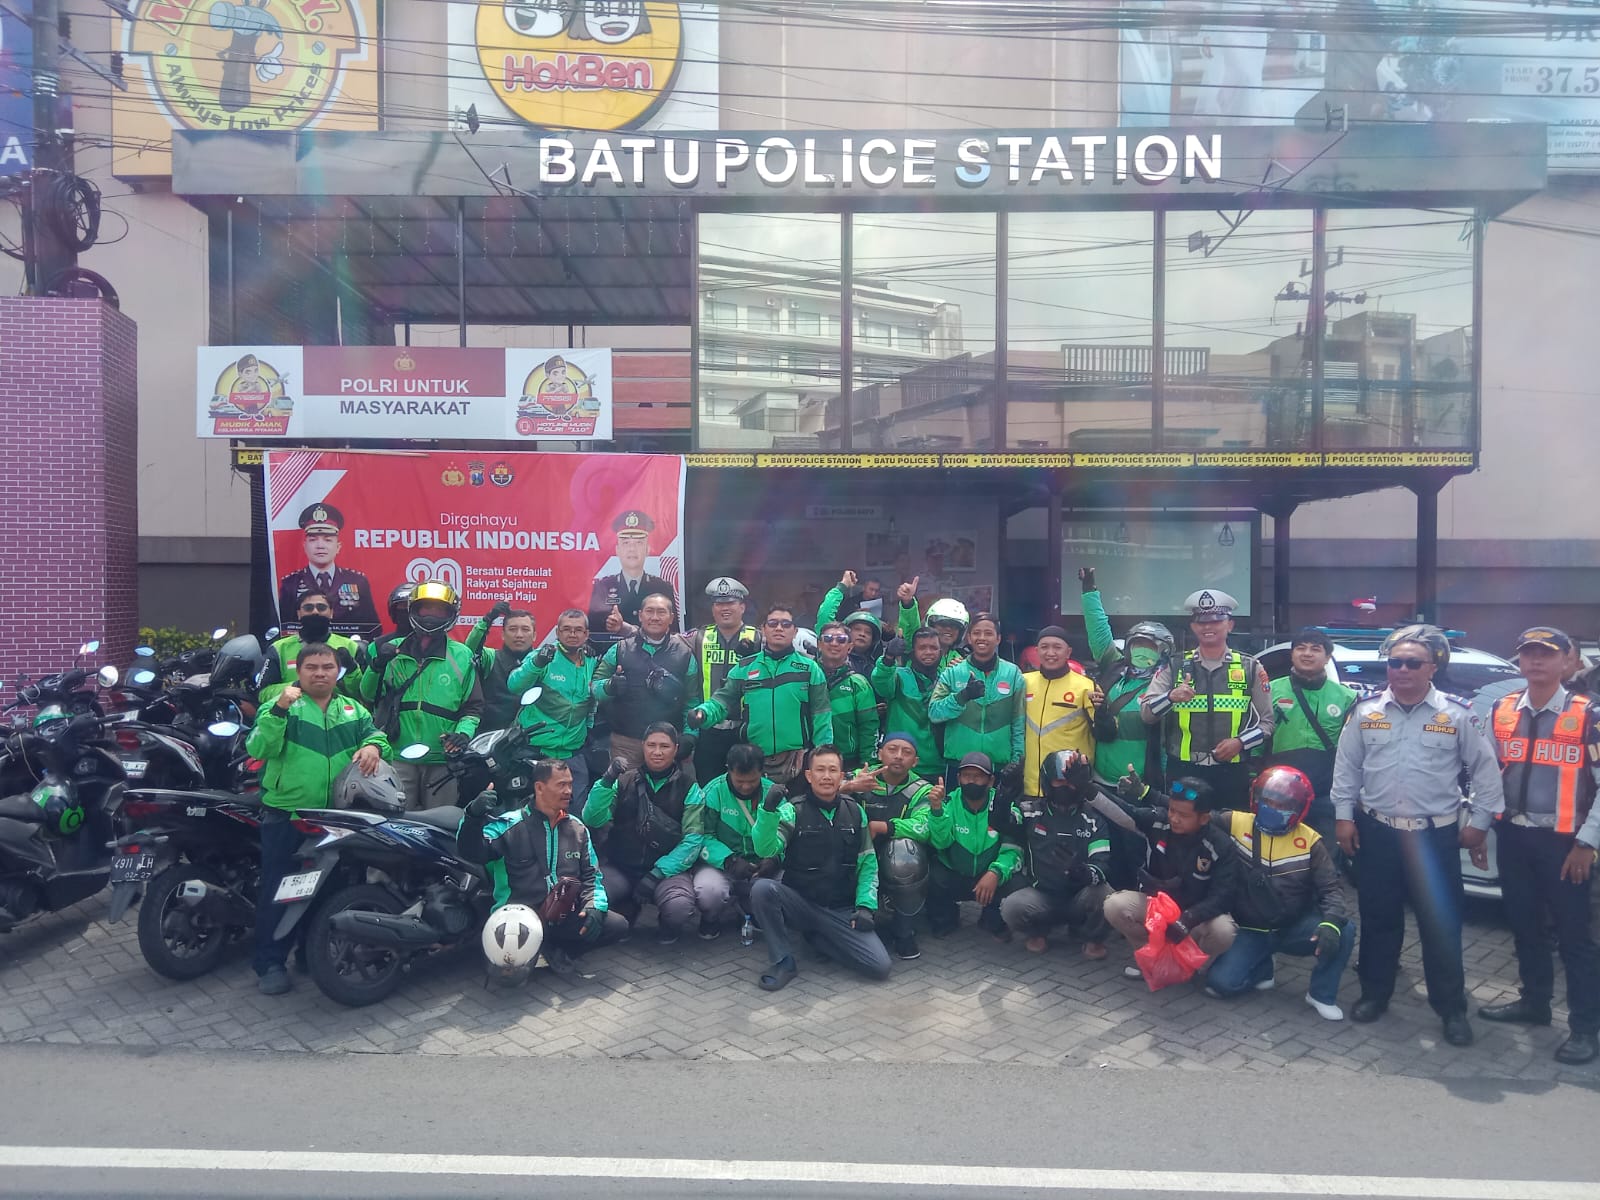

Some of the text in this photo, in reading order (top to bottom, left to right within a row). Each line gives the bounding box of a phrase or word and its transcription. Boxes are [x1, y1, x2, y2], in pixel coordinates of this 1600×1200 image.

[503, 54, 653, 92] HokBen
[167, 62, 323, 130] Always Low Prices
[539, 134, 1222, 185] BATU POLICE STATION
[341, 379, 469, 393] POLRI UNTUK
[341, 401, 470, 415] MASYARAKAT
[440, 513, 518, 529] Dirgahayu
[354, 530, 600, 551] REPUBLIK INDONESIA
[466, 566, 552, 577] Bersatu Berdaulat
[466, 578, 547, 591] Rakyat Sejahtera
[466, 590, 537, 603] Indonesia Maju
[1425, 725, 1455, 734] DISHUB
[1503, 741, 1523, 758] IS
[1536, 743, 1580, 763] HUB
[722, 806, 739, 817] Grab
[564, 850, 581, 860] Gra
